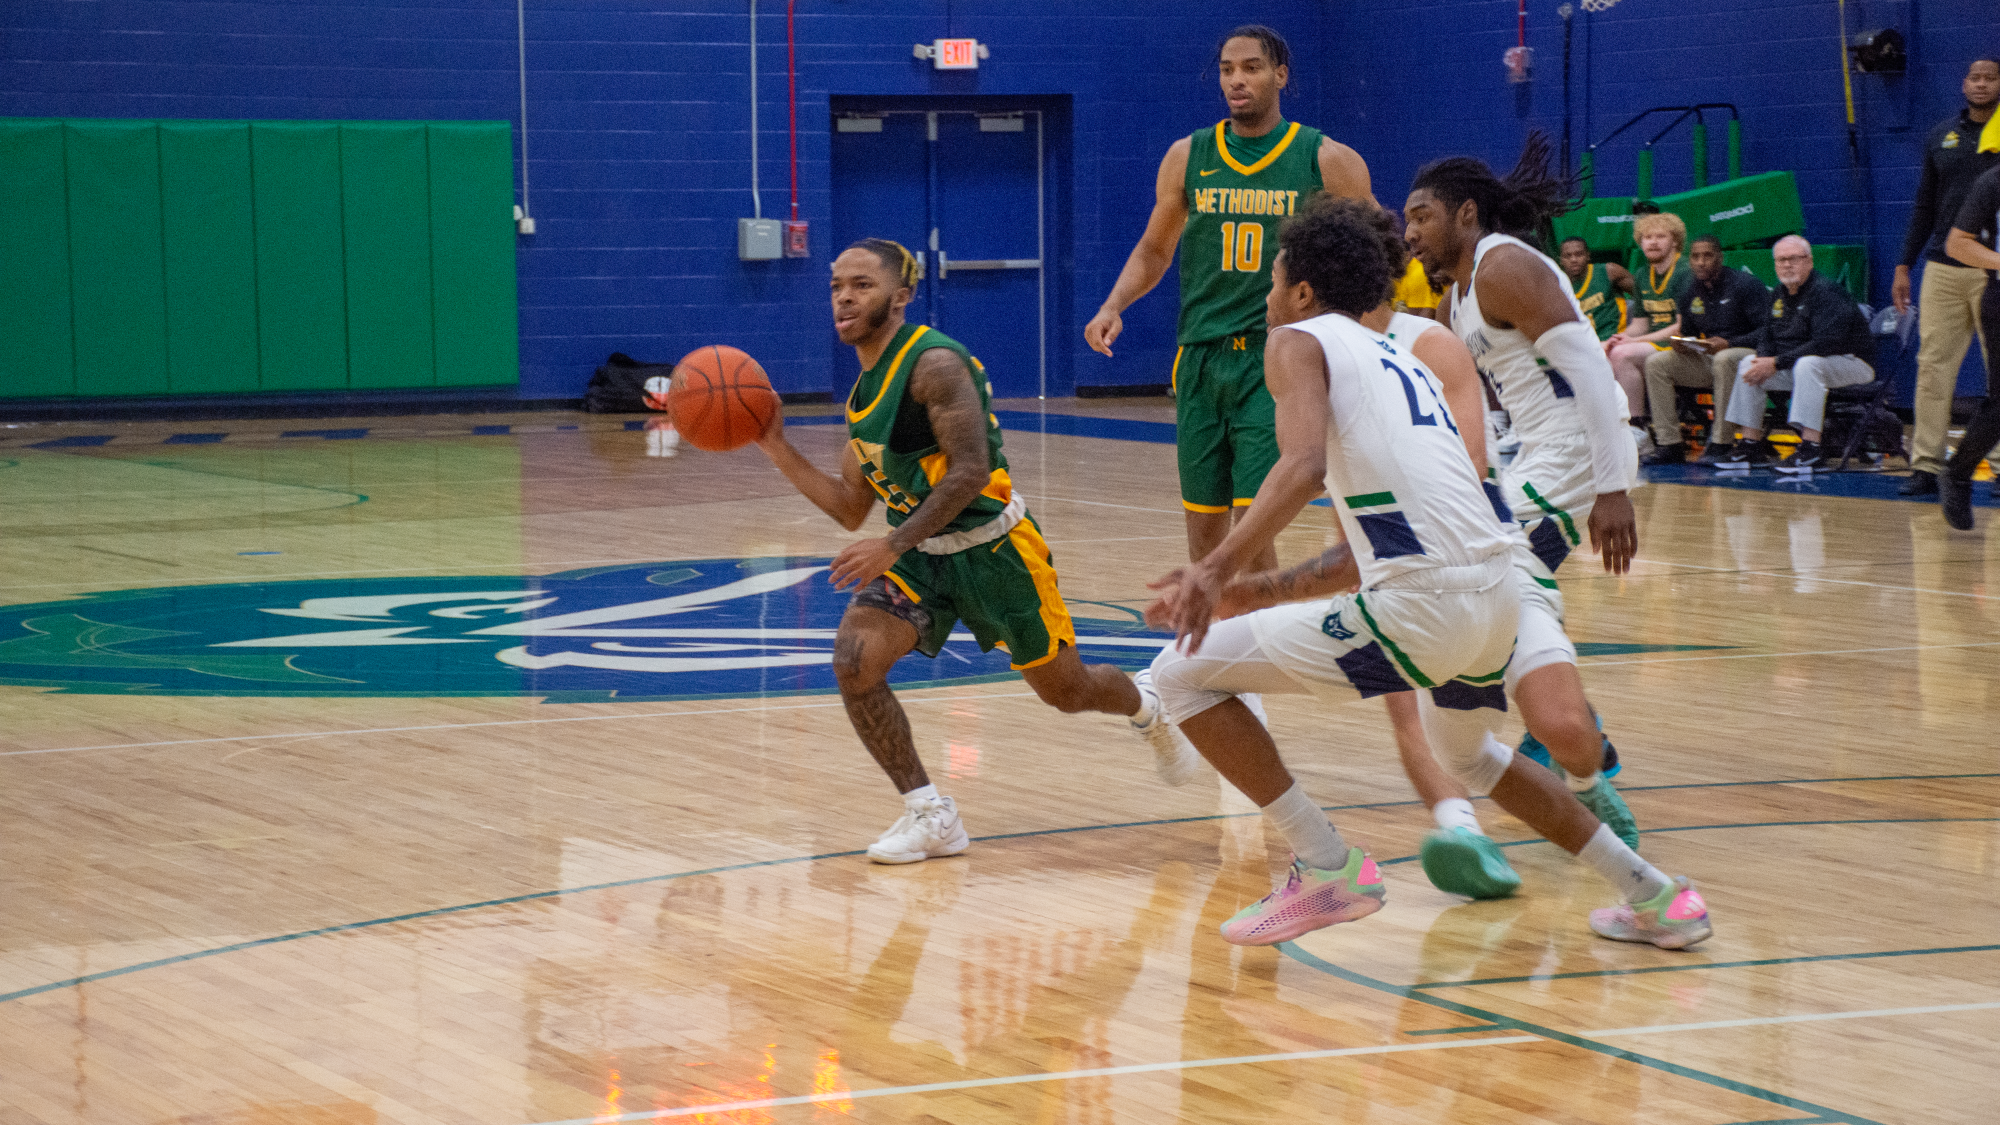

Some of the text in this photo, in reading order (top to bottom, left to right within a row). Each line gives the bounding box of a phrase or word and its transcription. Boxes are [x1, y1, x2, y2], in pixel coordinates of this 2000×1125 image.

[943, 40, 974, 66] EXIT
[1195, 187, 1299, 216] METHODIST
[1221, 221, 1264, 273] 10
